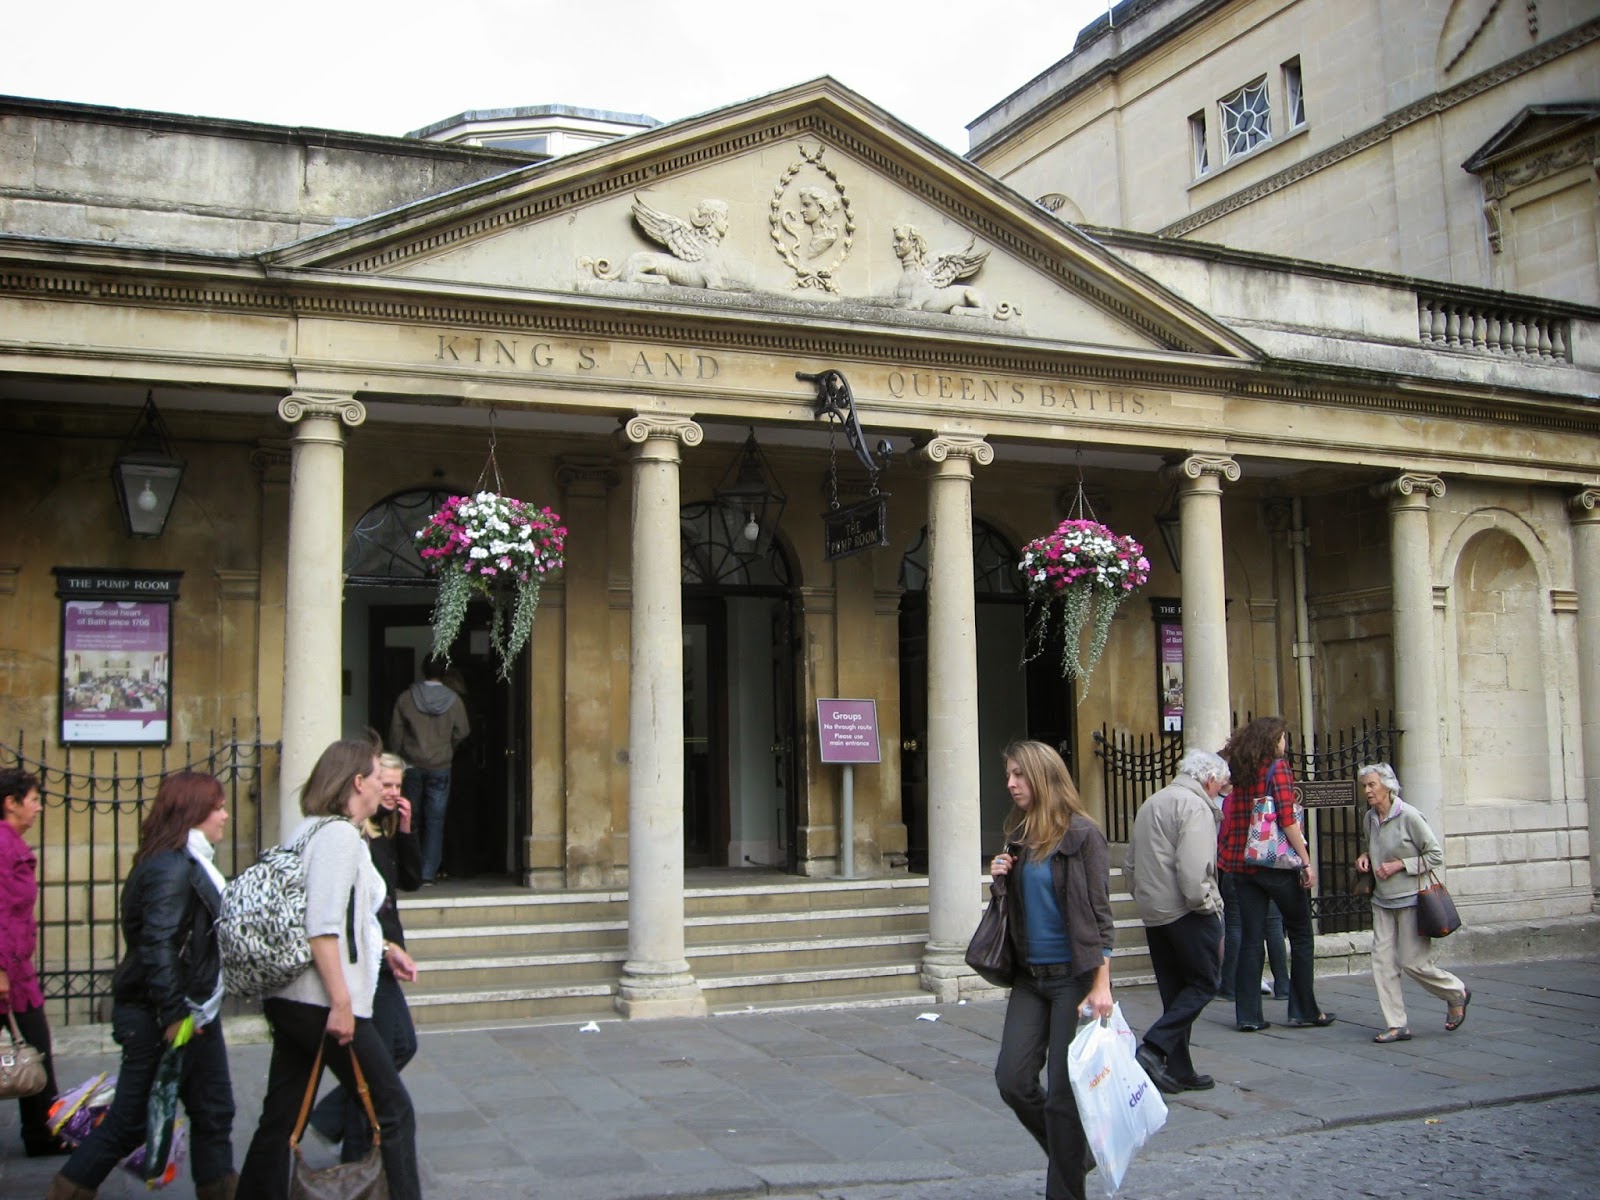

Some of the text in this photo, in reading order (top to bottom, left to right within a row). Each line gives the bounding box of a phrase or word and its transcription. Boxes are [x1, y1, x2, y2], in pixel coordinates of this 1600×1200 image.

[631, 351, 720, 380] AND
[1039, 385, 1145, 415] BATHS
[845, 520, 861, 536] THE
[831, 530, 877, 554] PUMP ROOM
[69, 578, 169, 590] THE PUMP ROOM
[1160, 606, 1176, 614] THE
[87, 618, 107, 626] Bath
[108, 618, 130, 626] since
[832, 711, 862, 721] Groups
[834, 723, 857, 731] through
